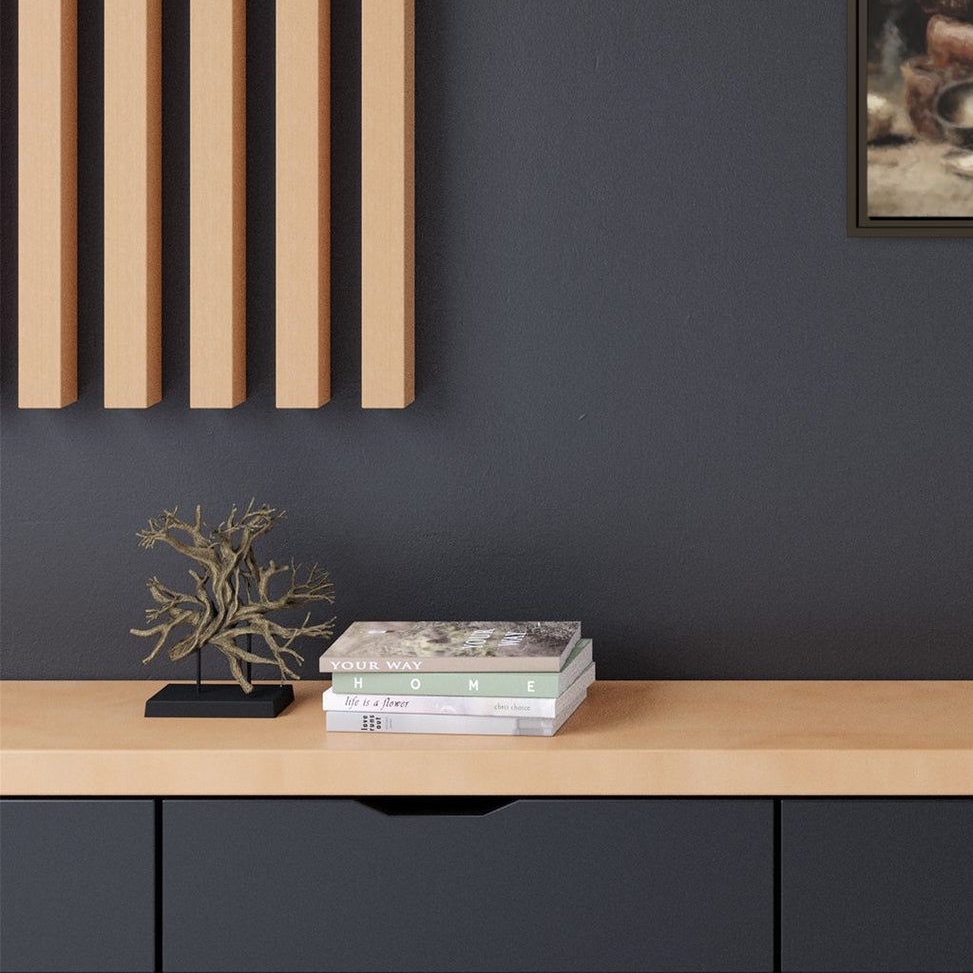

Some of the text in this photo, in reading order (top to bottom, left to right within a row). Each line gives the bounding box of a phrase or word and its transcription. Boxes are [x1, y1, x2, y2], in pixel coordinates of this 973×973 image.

[330, 661, 423, 670] YOUR WAY
[345, 696, 360, 709] life
[362, 697, 371, 707] is
[380, 697, 410, 710] flower
